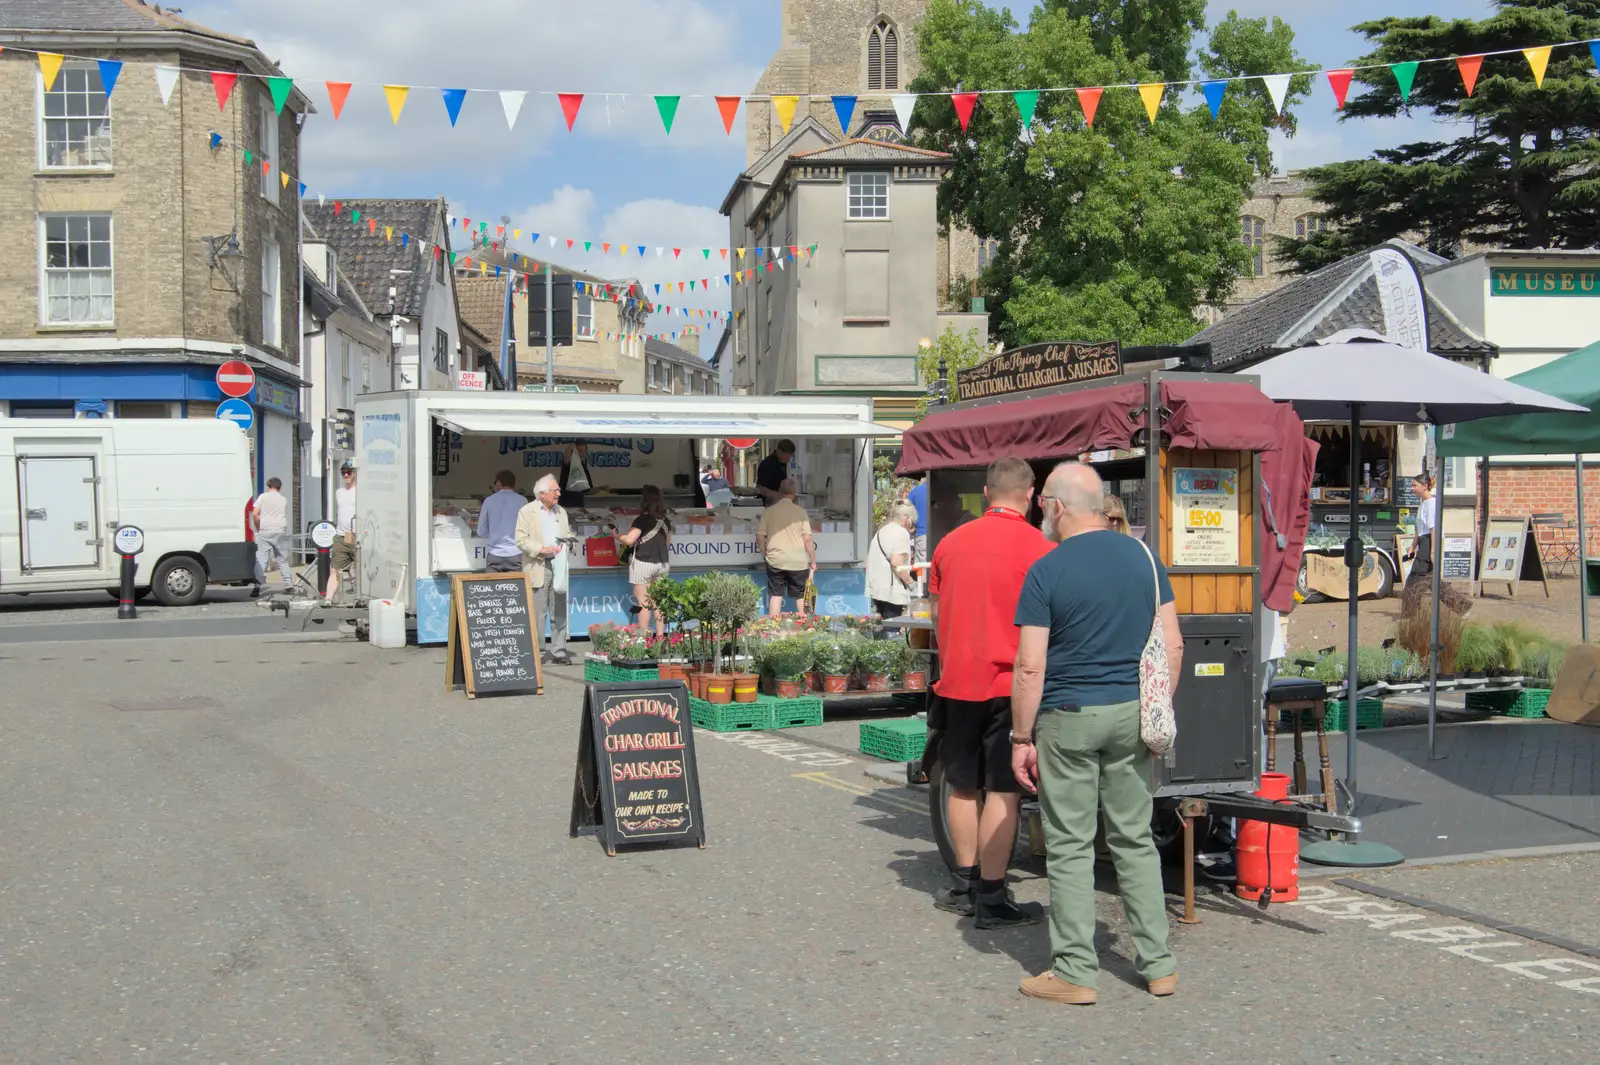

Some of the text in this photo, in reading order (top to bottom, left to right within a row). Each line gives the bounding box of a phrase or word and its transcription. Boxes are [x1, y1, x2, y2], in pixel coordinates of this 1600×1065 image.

[1497, 272, 1596, 291] MUSEU
[1044, 344, 1071, 363] Chef
[458, 380, 483, 388] ICENCE
[959, 375, 1016, 399] TRADITIONAL
[1016, 367, 1067, 388] CHARGRILL
[1068, 356, 1119, 380] SAUSAGES
[667, 542, 760, 555] AROUND THE
[469, 583, 519, 594] SPECIAL OFFERS
[506, 598, 517, 606] SEA
[570, 594, 639, 614] MERY'S
[468, 608, 483, 617] BASS
[493, 607, 503, 615] SEA
[505, 606, 526, 615] BREAM
[476, 616, 513, 625] FILLETS £10
[484, 629, 501, 637] FRESH
[600, 698, 681, 728] TRADITIONAL
[612, 760, 682, 781] SAUSAGES
[628, 789, 669, 801] MADE TO
[615, 802, 684, 818] OUR OWN RECIPE
